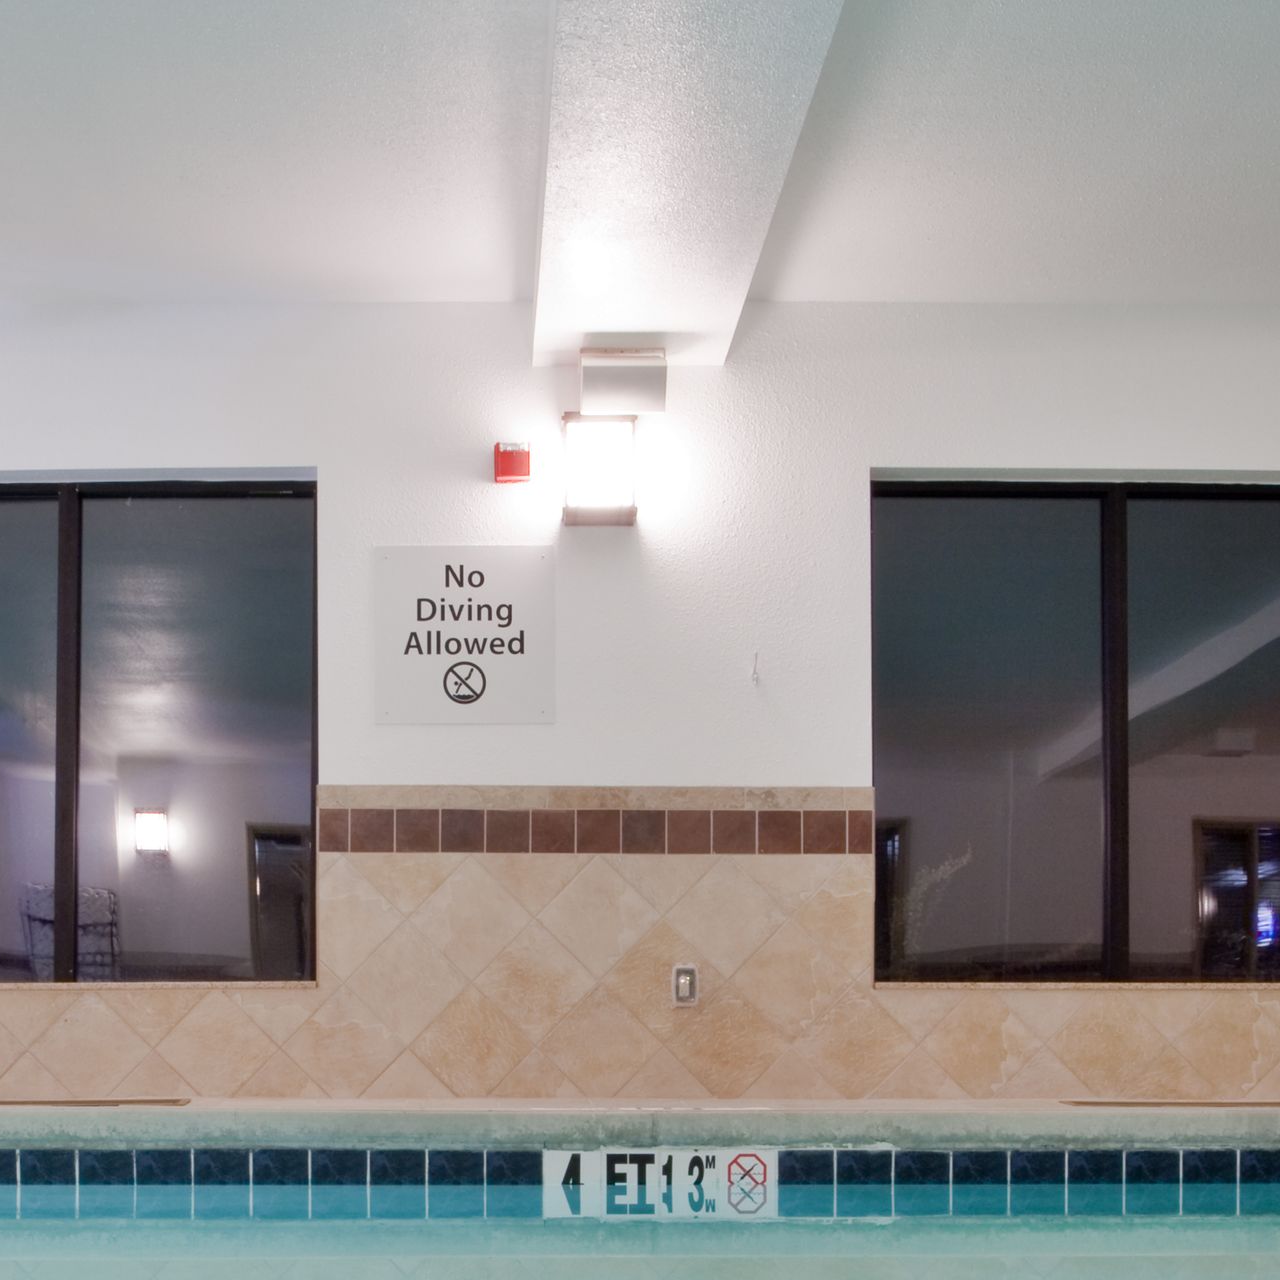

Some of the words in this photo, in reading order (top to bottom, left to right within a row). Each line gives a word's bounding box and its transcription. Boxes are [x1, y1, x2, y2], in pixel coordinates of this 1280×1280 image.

[444, 564, 485, 588] No
[416, 597, 513, 628] Diving
[403, 629, 525, 656] Allowed
